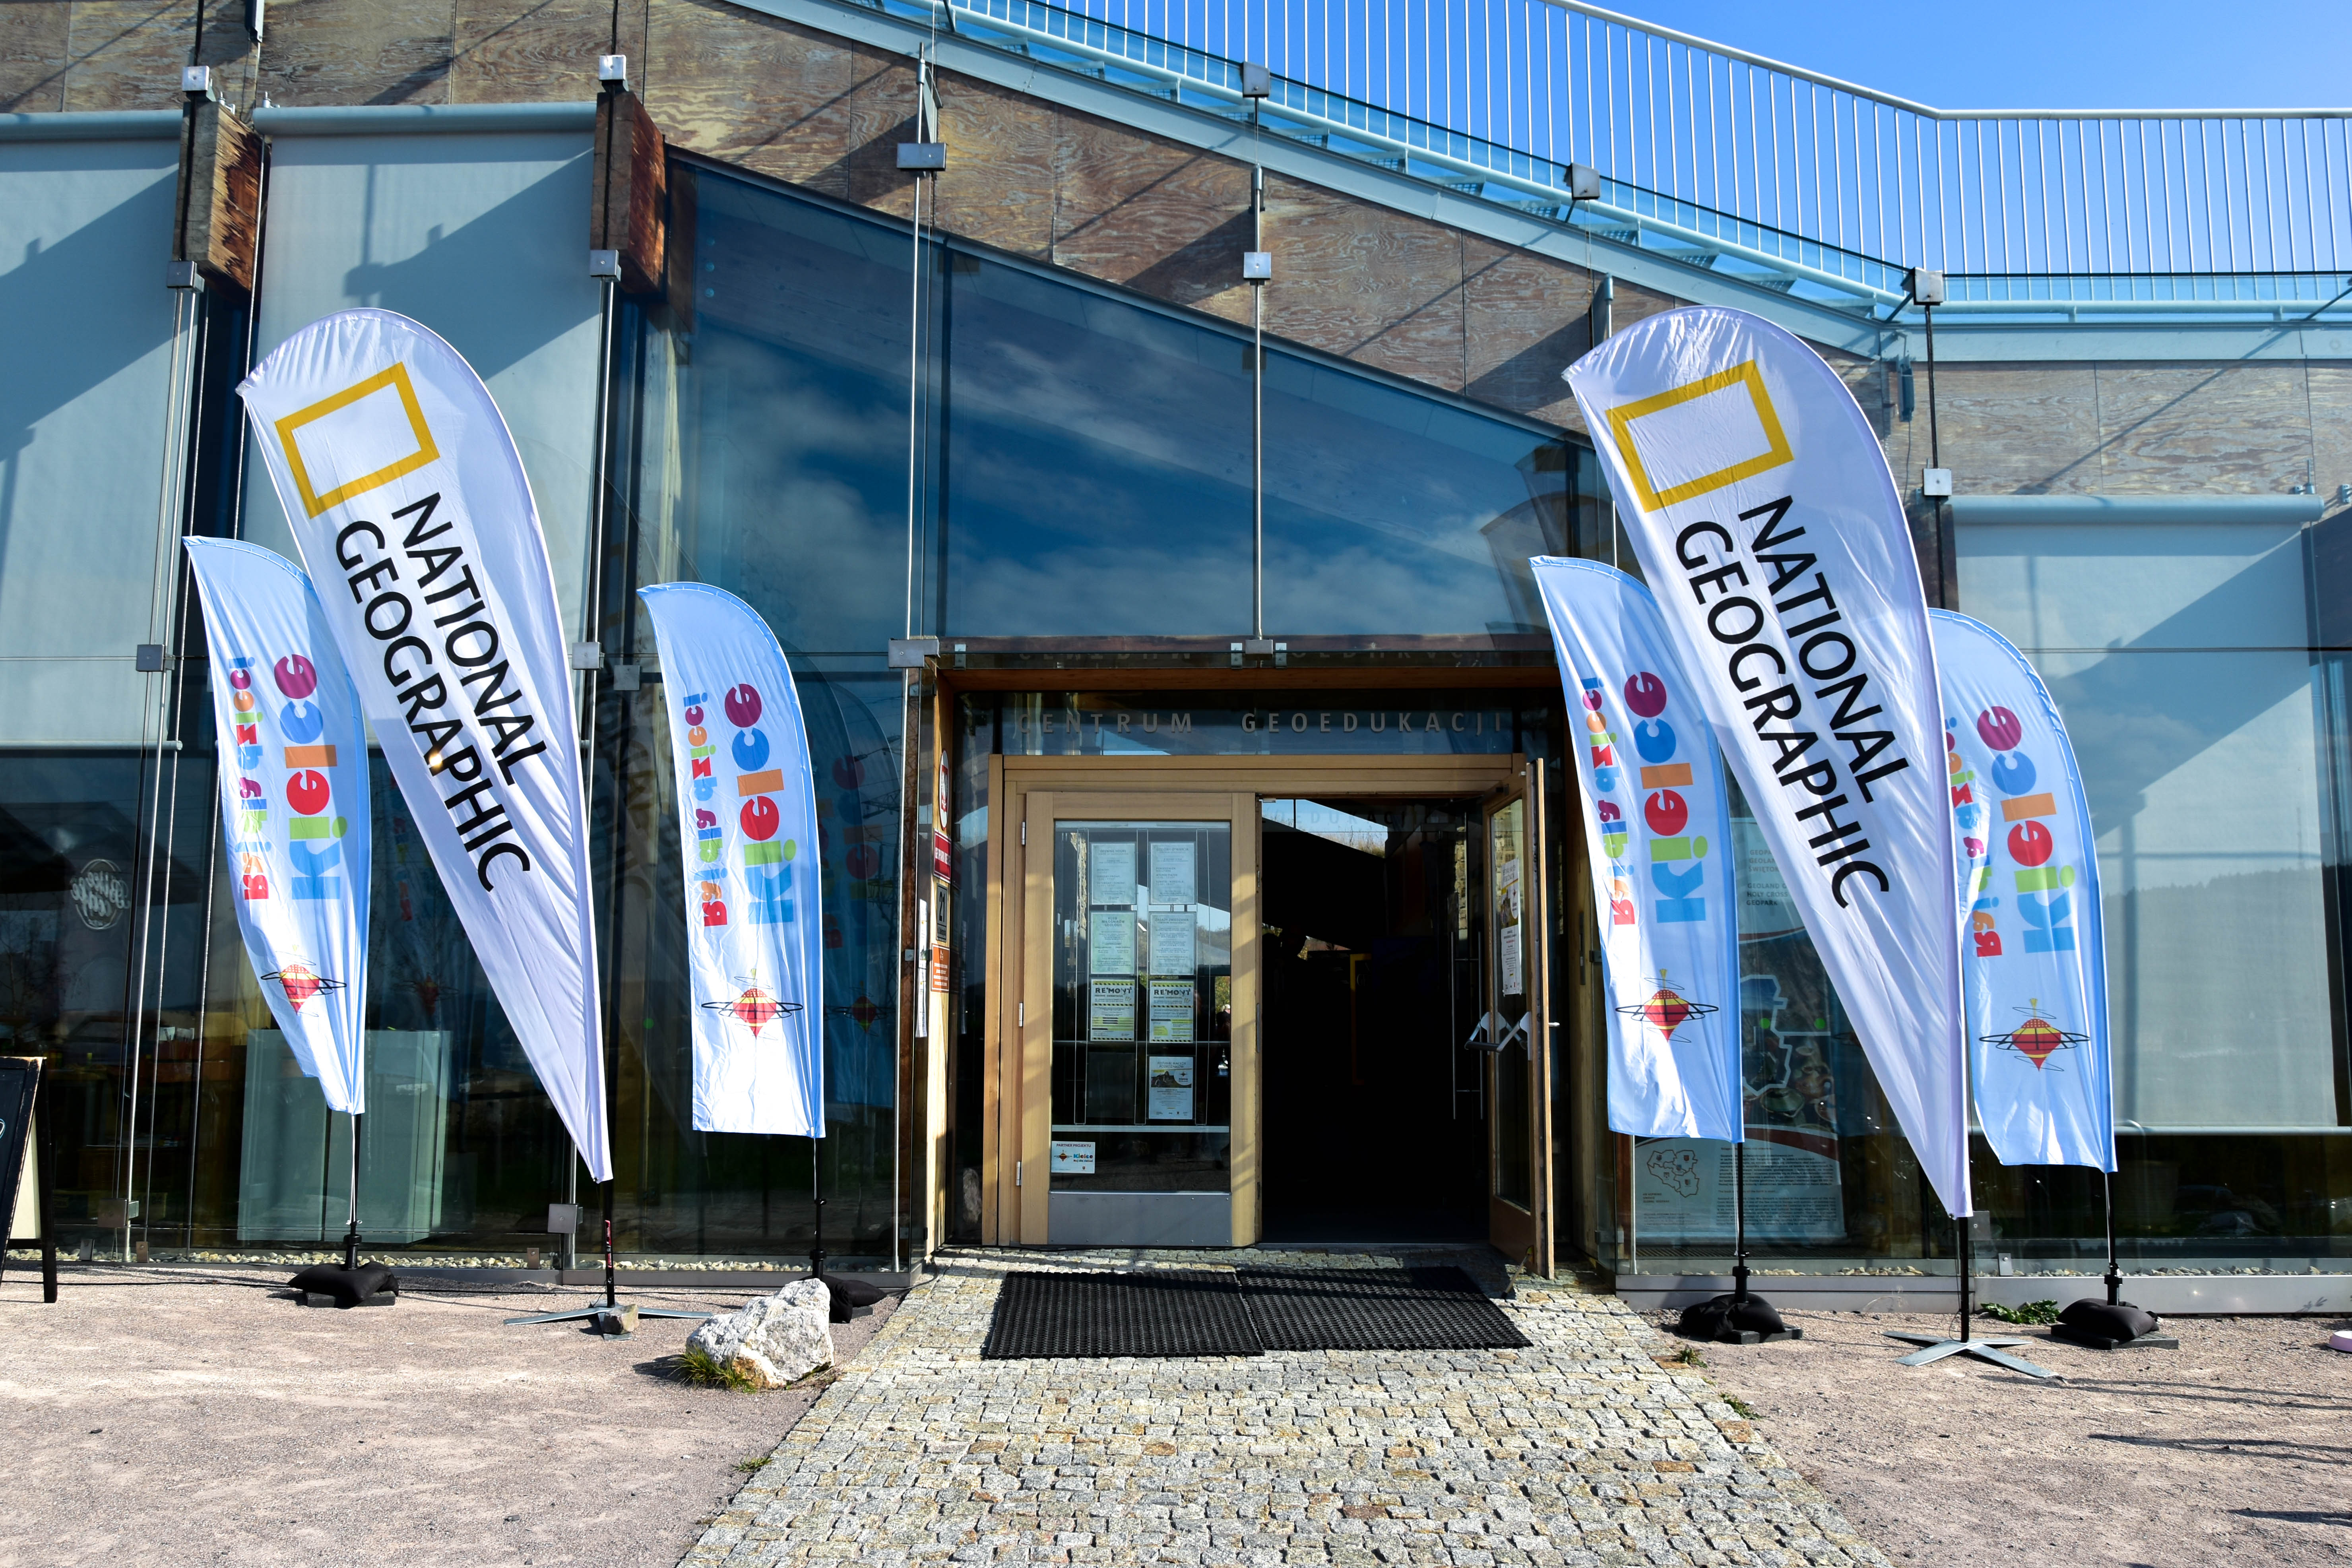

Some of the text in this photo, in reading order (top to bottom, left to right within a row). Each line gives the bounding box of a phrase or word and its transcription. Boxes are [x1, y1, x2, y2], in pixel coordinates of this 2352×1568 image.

[335, 519, 530, 892] GEOGRAPHIC
[392, 492, 548, 786] NATIONAL
[1016, 711, 1502, 737] CENTRUM GEOEDUKACJI
[1675, 520, 1889, 909] GEOGRAPHIC
[1738, 495, 1909, 804] NATIONAL
[939, 891, 945, 923] 21
